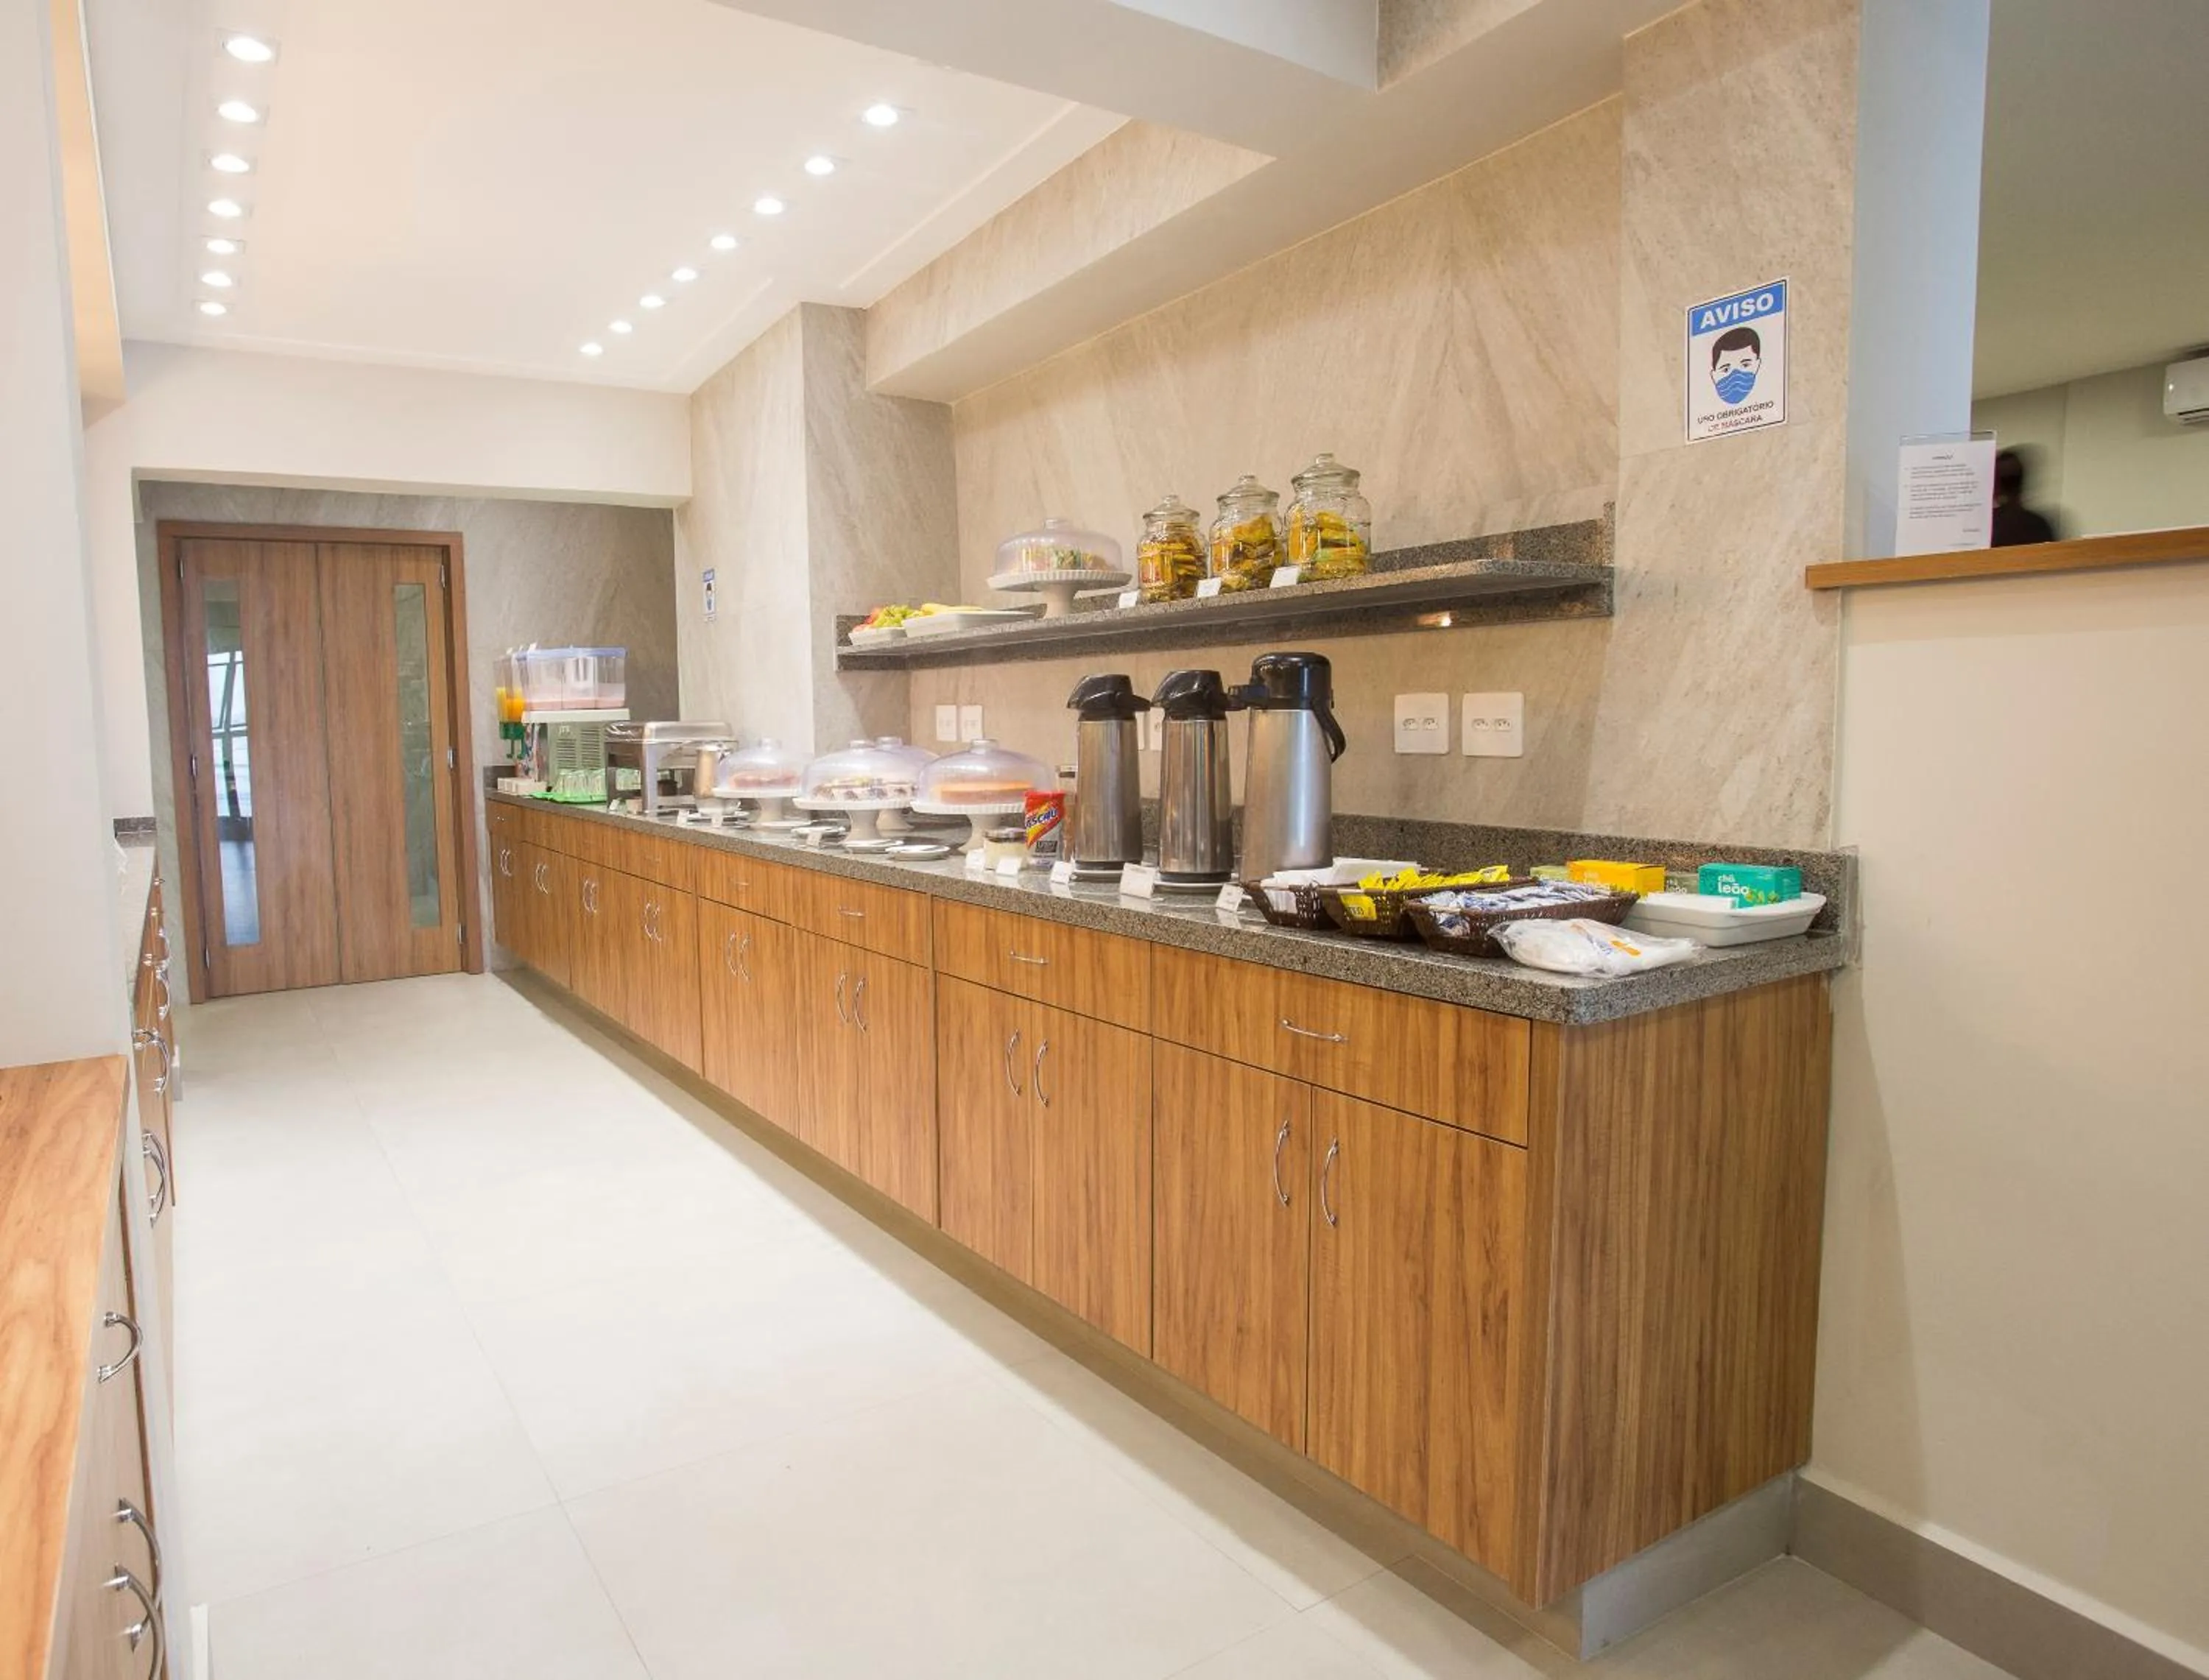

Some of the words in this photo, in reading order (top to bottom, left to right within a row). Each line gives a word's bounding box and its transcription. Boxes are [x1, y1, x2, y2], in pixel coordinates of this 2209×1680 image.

[1700, 292, 1775, 329] AVISO
[1697, 414, 1715, 425] USO
[1718, 882, 1750, 896] leão
